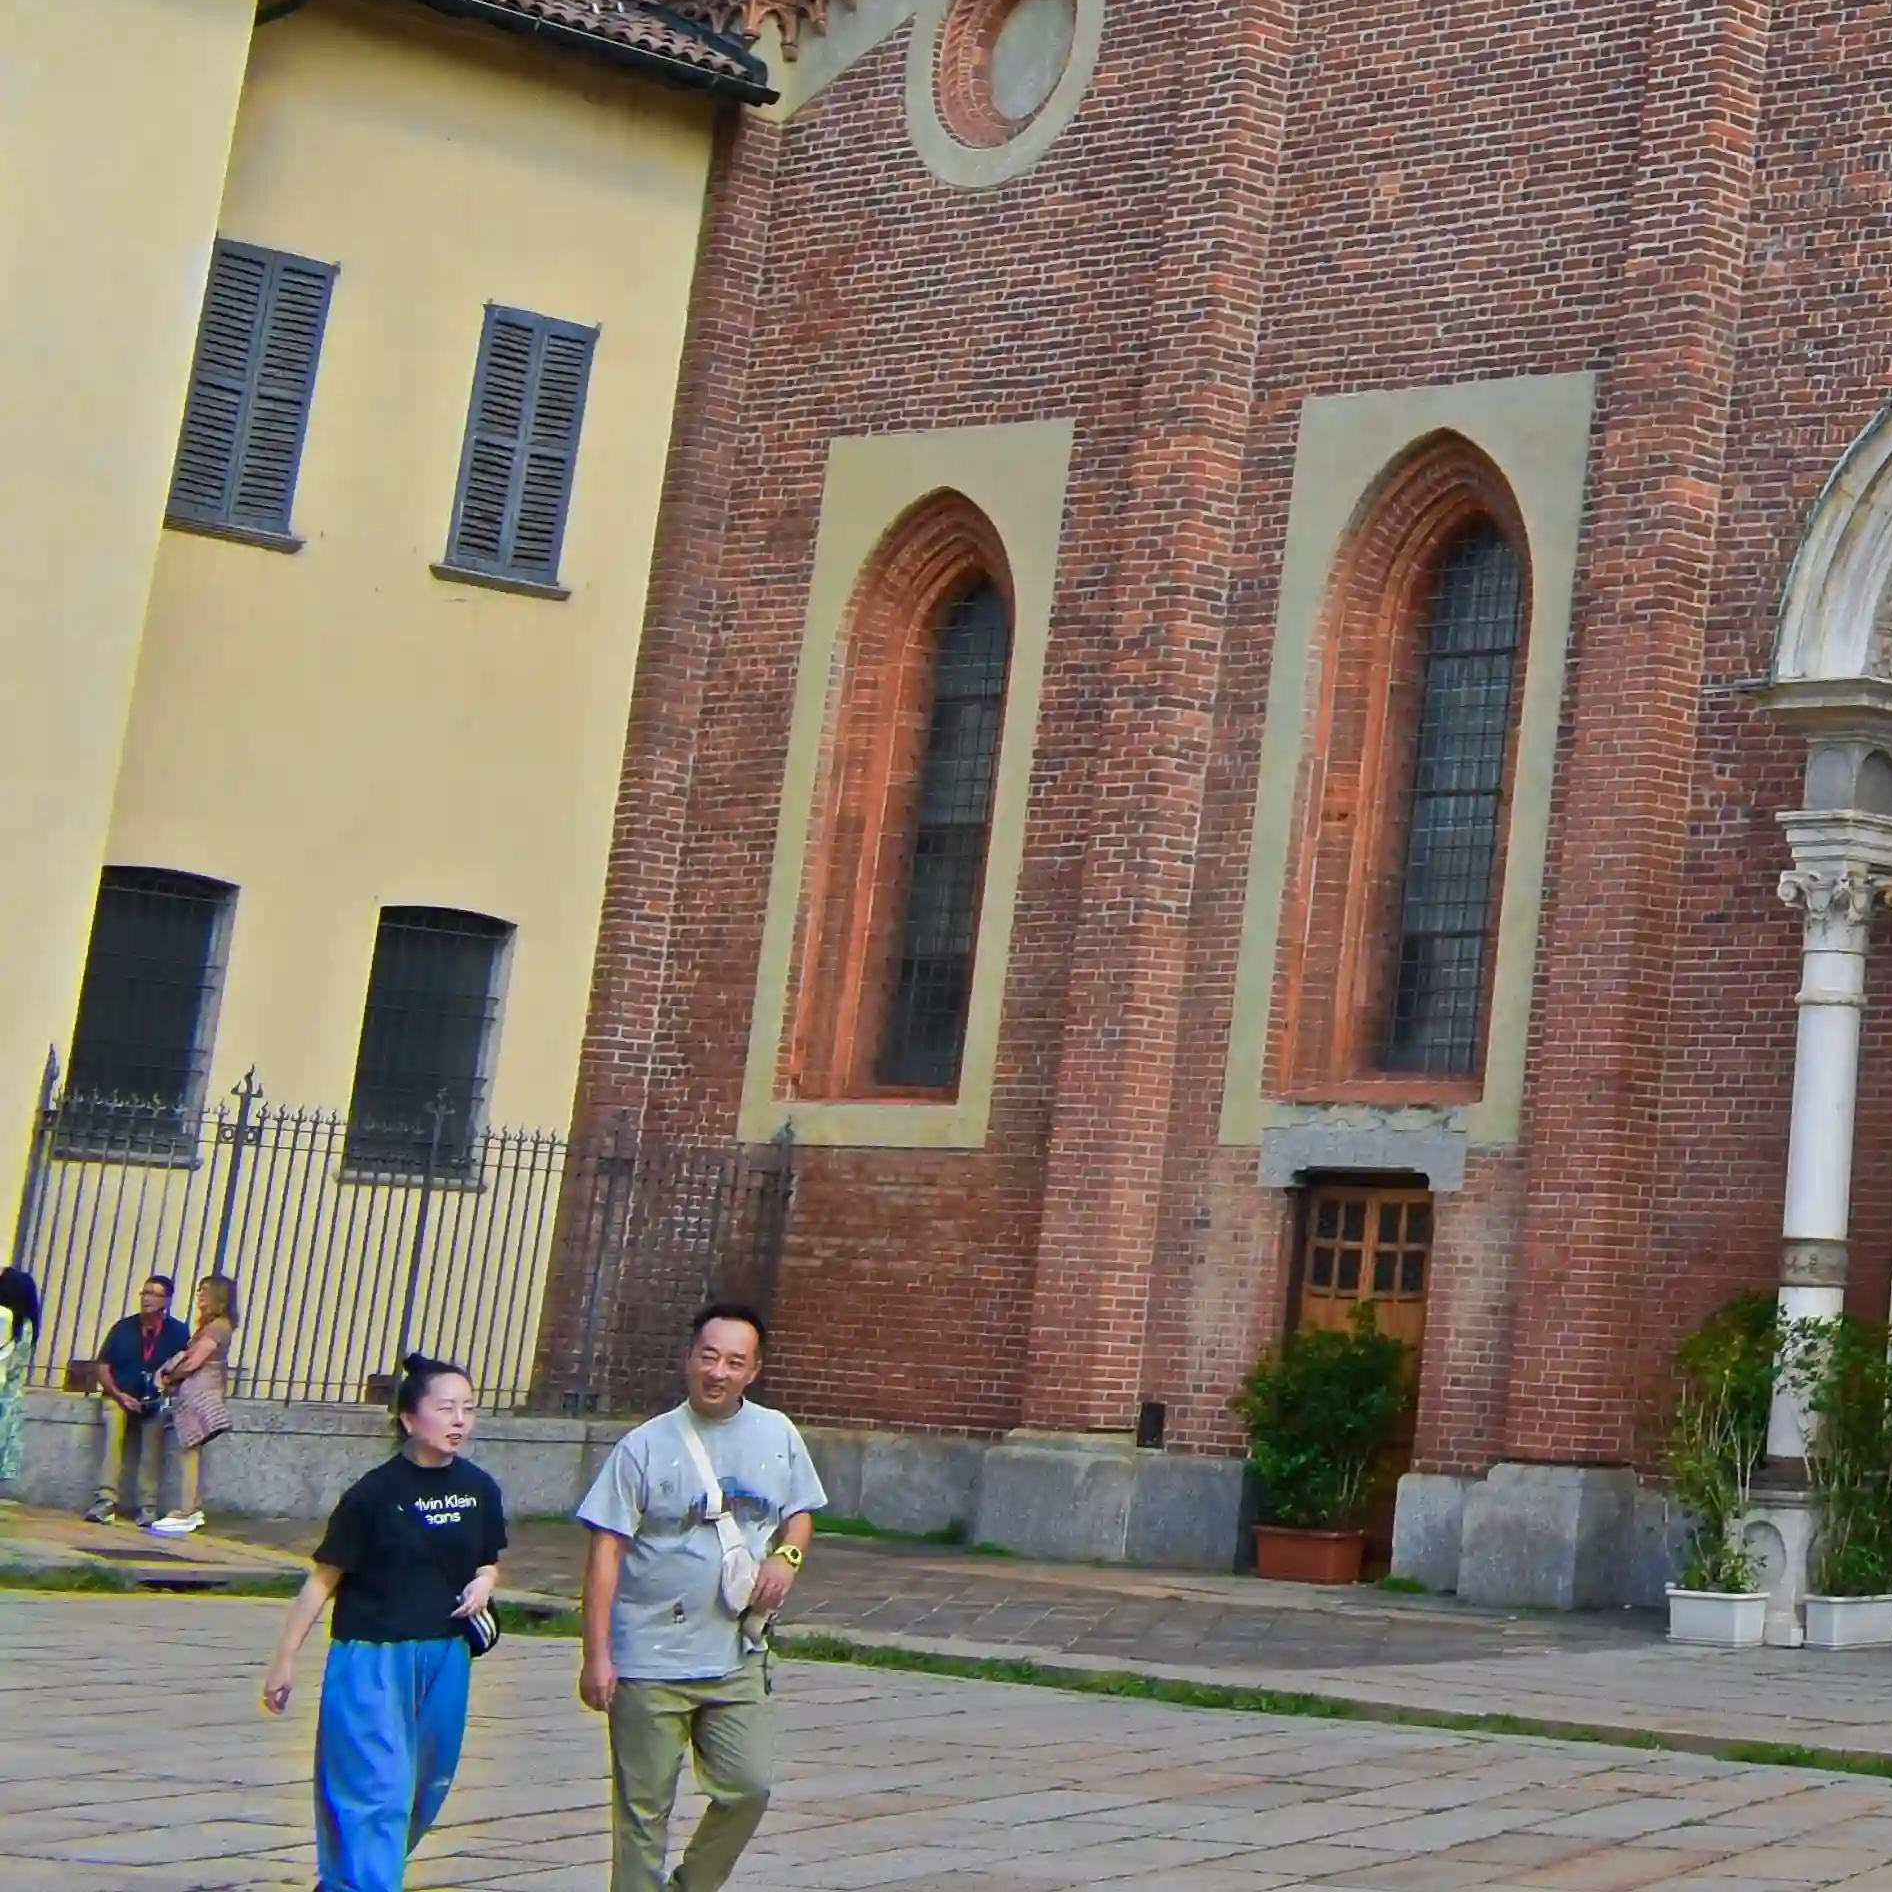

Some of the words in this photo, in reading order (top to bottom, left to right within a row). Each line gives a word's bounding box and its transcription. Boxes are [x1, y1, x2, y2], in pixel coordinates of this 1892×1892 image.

[398, 1497, 443, 1512] lvin
[444, 1494, 477, 1509] Klein
[424, 1512, 461, 1525] eans
